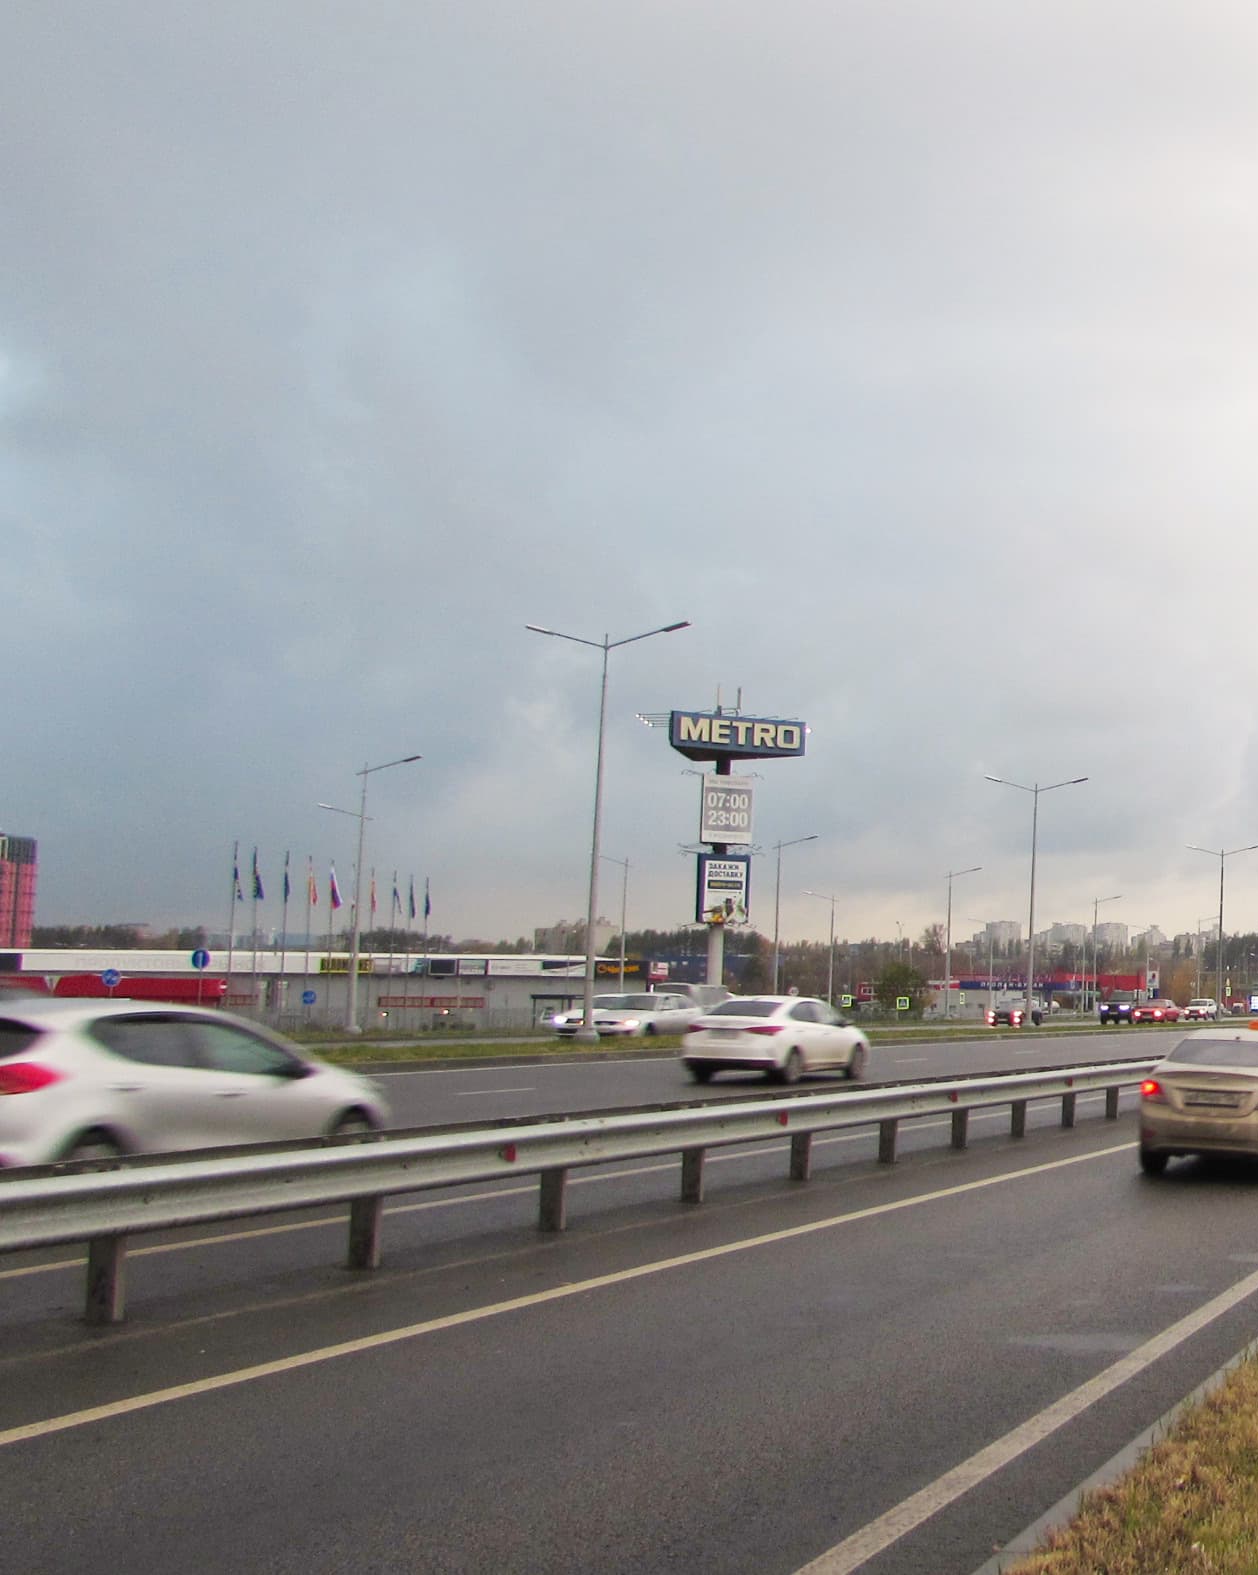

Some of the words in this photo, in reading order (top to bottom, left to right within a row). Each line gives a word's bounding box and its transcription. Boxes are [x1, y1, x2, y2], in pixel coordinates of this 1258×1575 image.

[680, 716, 800, 749] METRO
[707, 792, 749, 809] 07:00
[707, 810, 748, 827] 23:00
